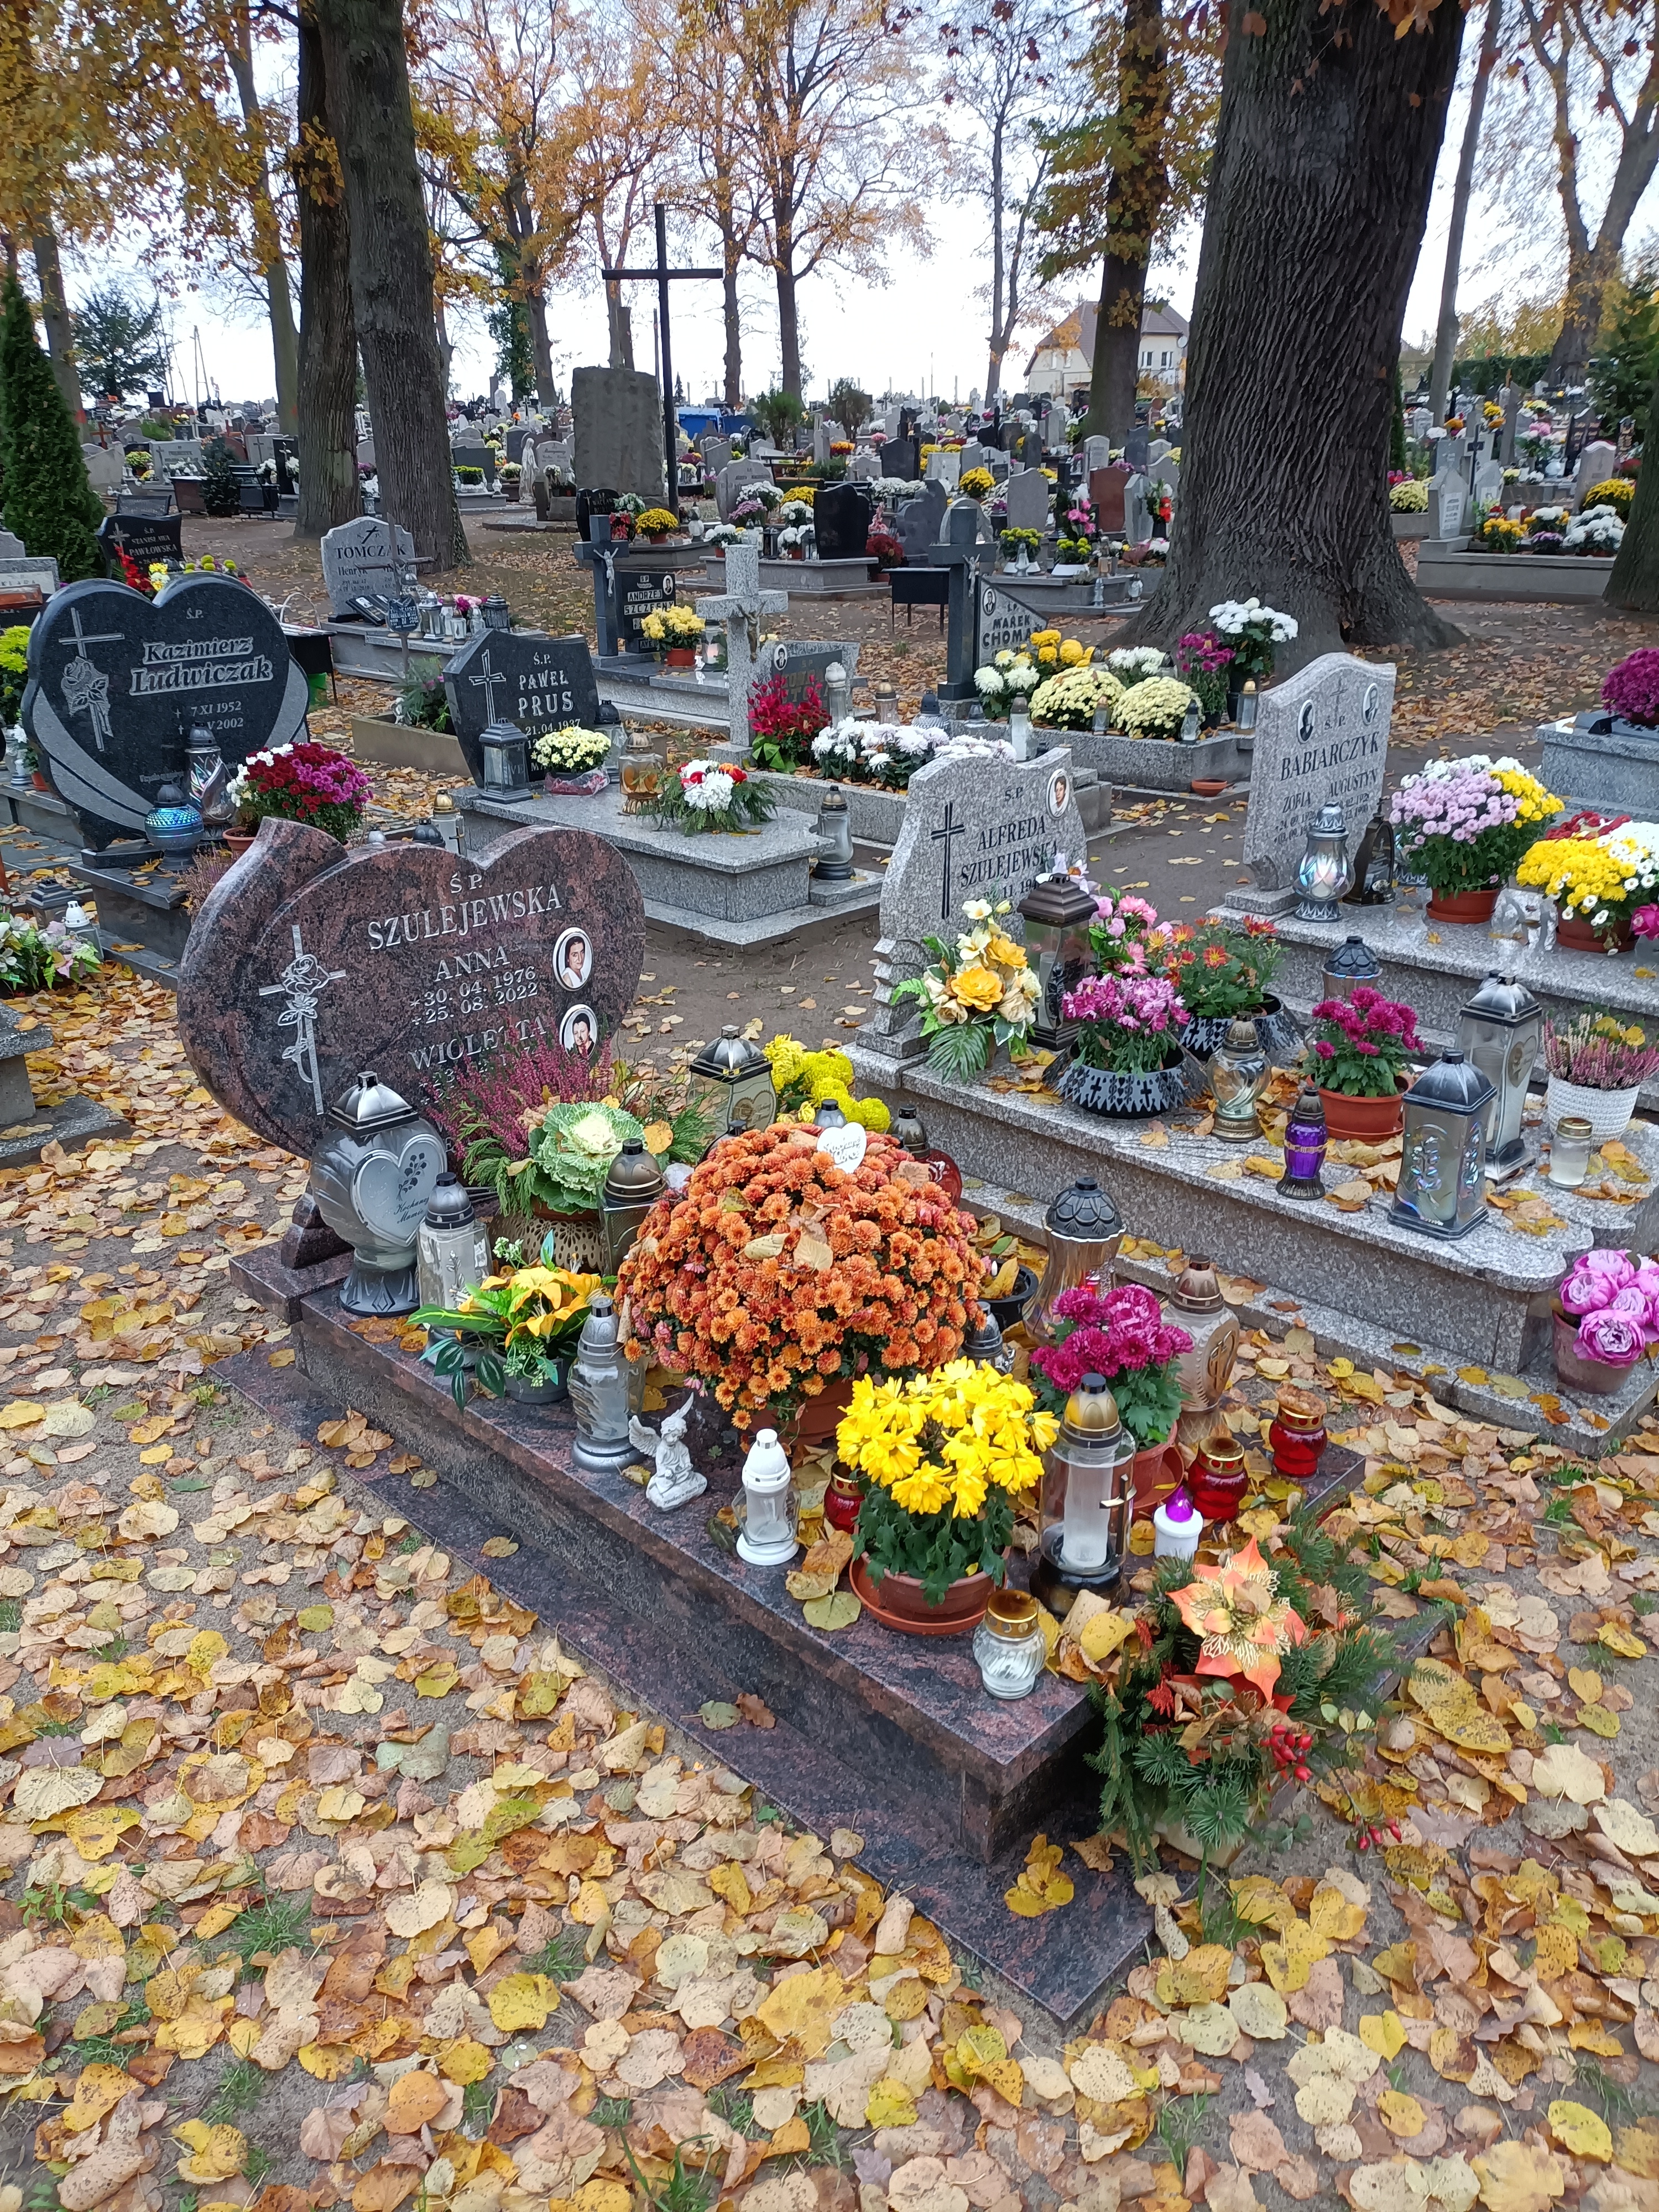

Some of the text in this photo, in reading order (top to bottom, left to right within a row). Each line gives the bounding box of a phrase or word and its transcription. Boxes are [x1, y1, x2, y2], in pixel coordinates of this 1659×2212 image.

[129, 544, 178, 556] PAWŁOWSKA
[629, 590, 662, 601] ANDRZEJ
[993, 614, 1031, 630] MAREK
[144, 637, 253, 664] Kazimierz
[130, 654, 273, 695] Ludwiczak
[216, 700, 242, 713] 1952
[518, 691, 573, 718] PRUS
[216, 717, 244, 730] 2002
[1280, 732, 1380, 781] BABIARCZYK
[1282, 791, 1311, 813] ZOFIA
[977, 815, 1046, 852] ALFREDA
[368, 883, 562, 950] SZULEJEWSKA
[434, 945, 510, 982] ANNA
[492, 966, 536, 989] 1976
[494, 982, 538, 1006] 2022
[397, 1208, 424, 1224] Mamie
